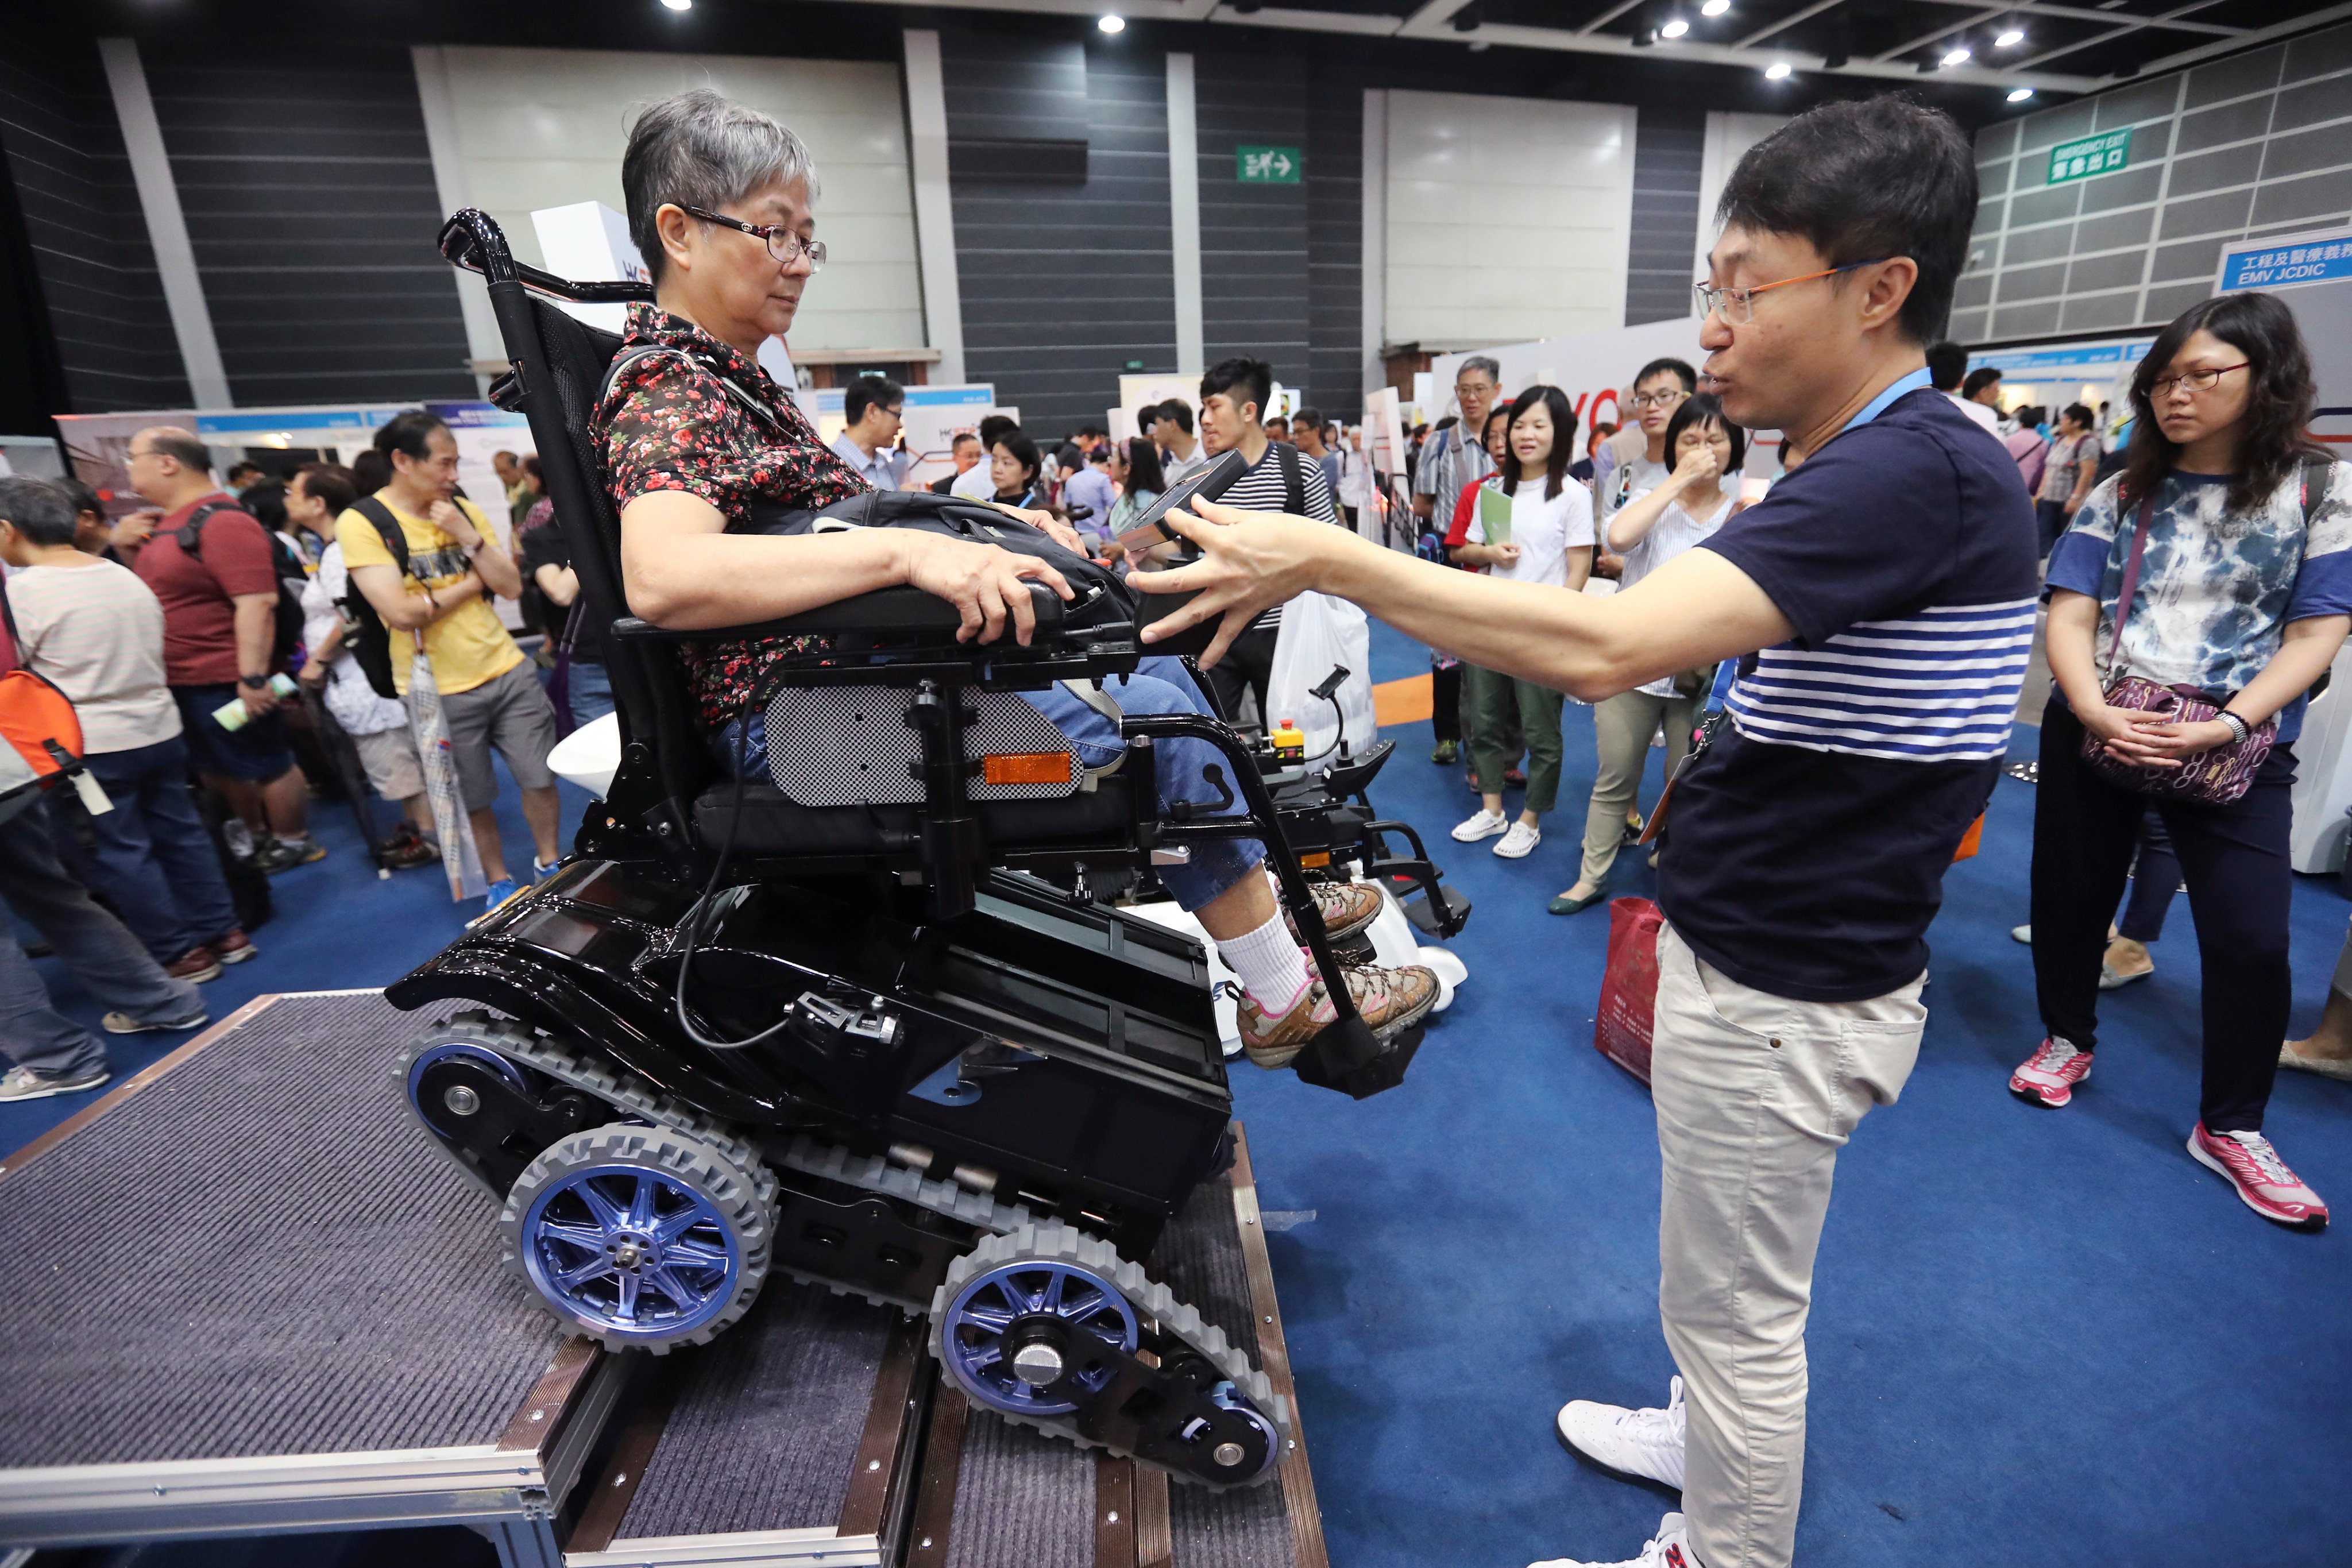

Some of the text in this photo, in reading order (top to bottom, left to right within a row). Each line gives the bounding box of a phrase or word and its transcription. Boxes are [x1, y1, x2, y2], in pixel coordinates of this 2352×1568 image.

[2104, 133, 2126, 150] EXIT
[2238, 263, 2326, 285] EMV JCDIC
